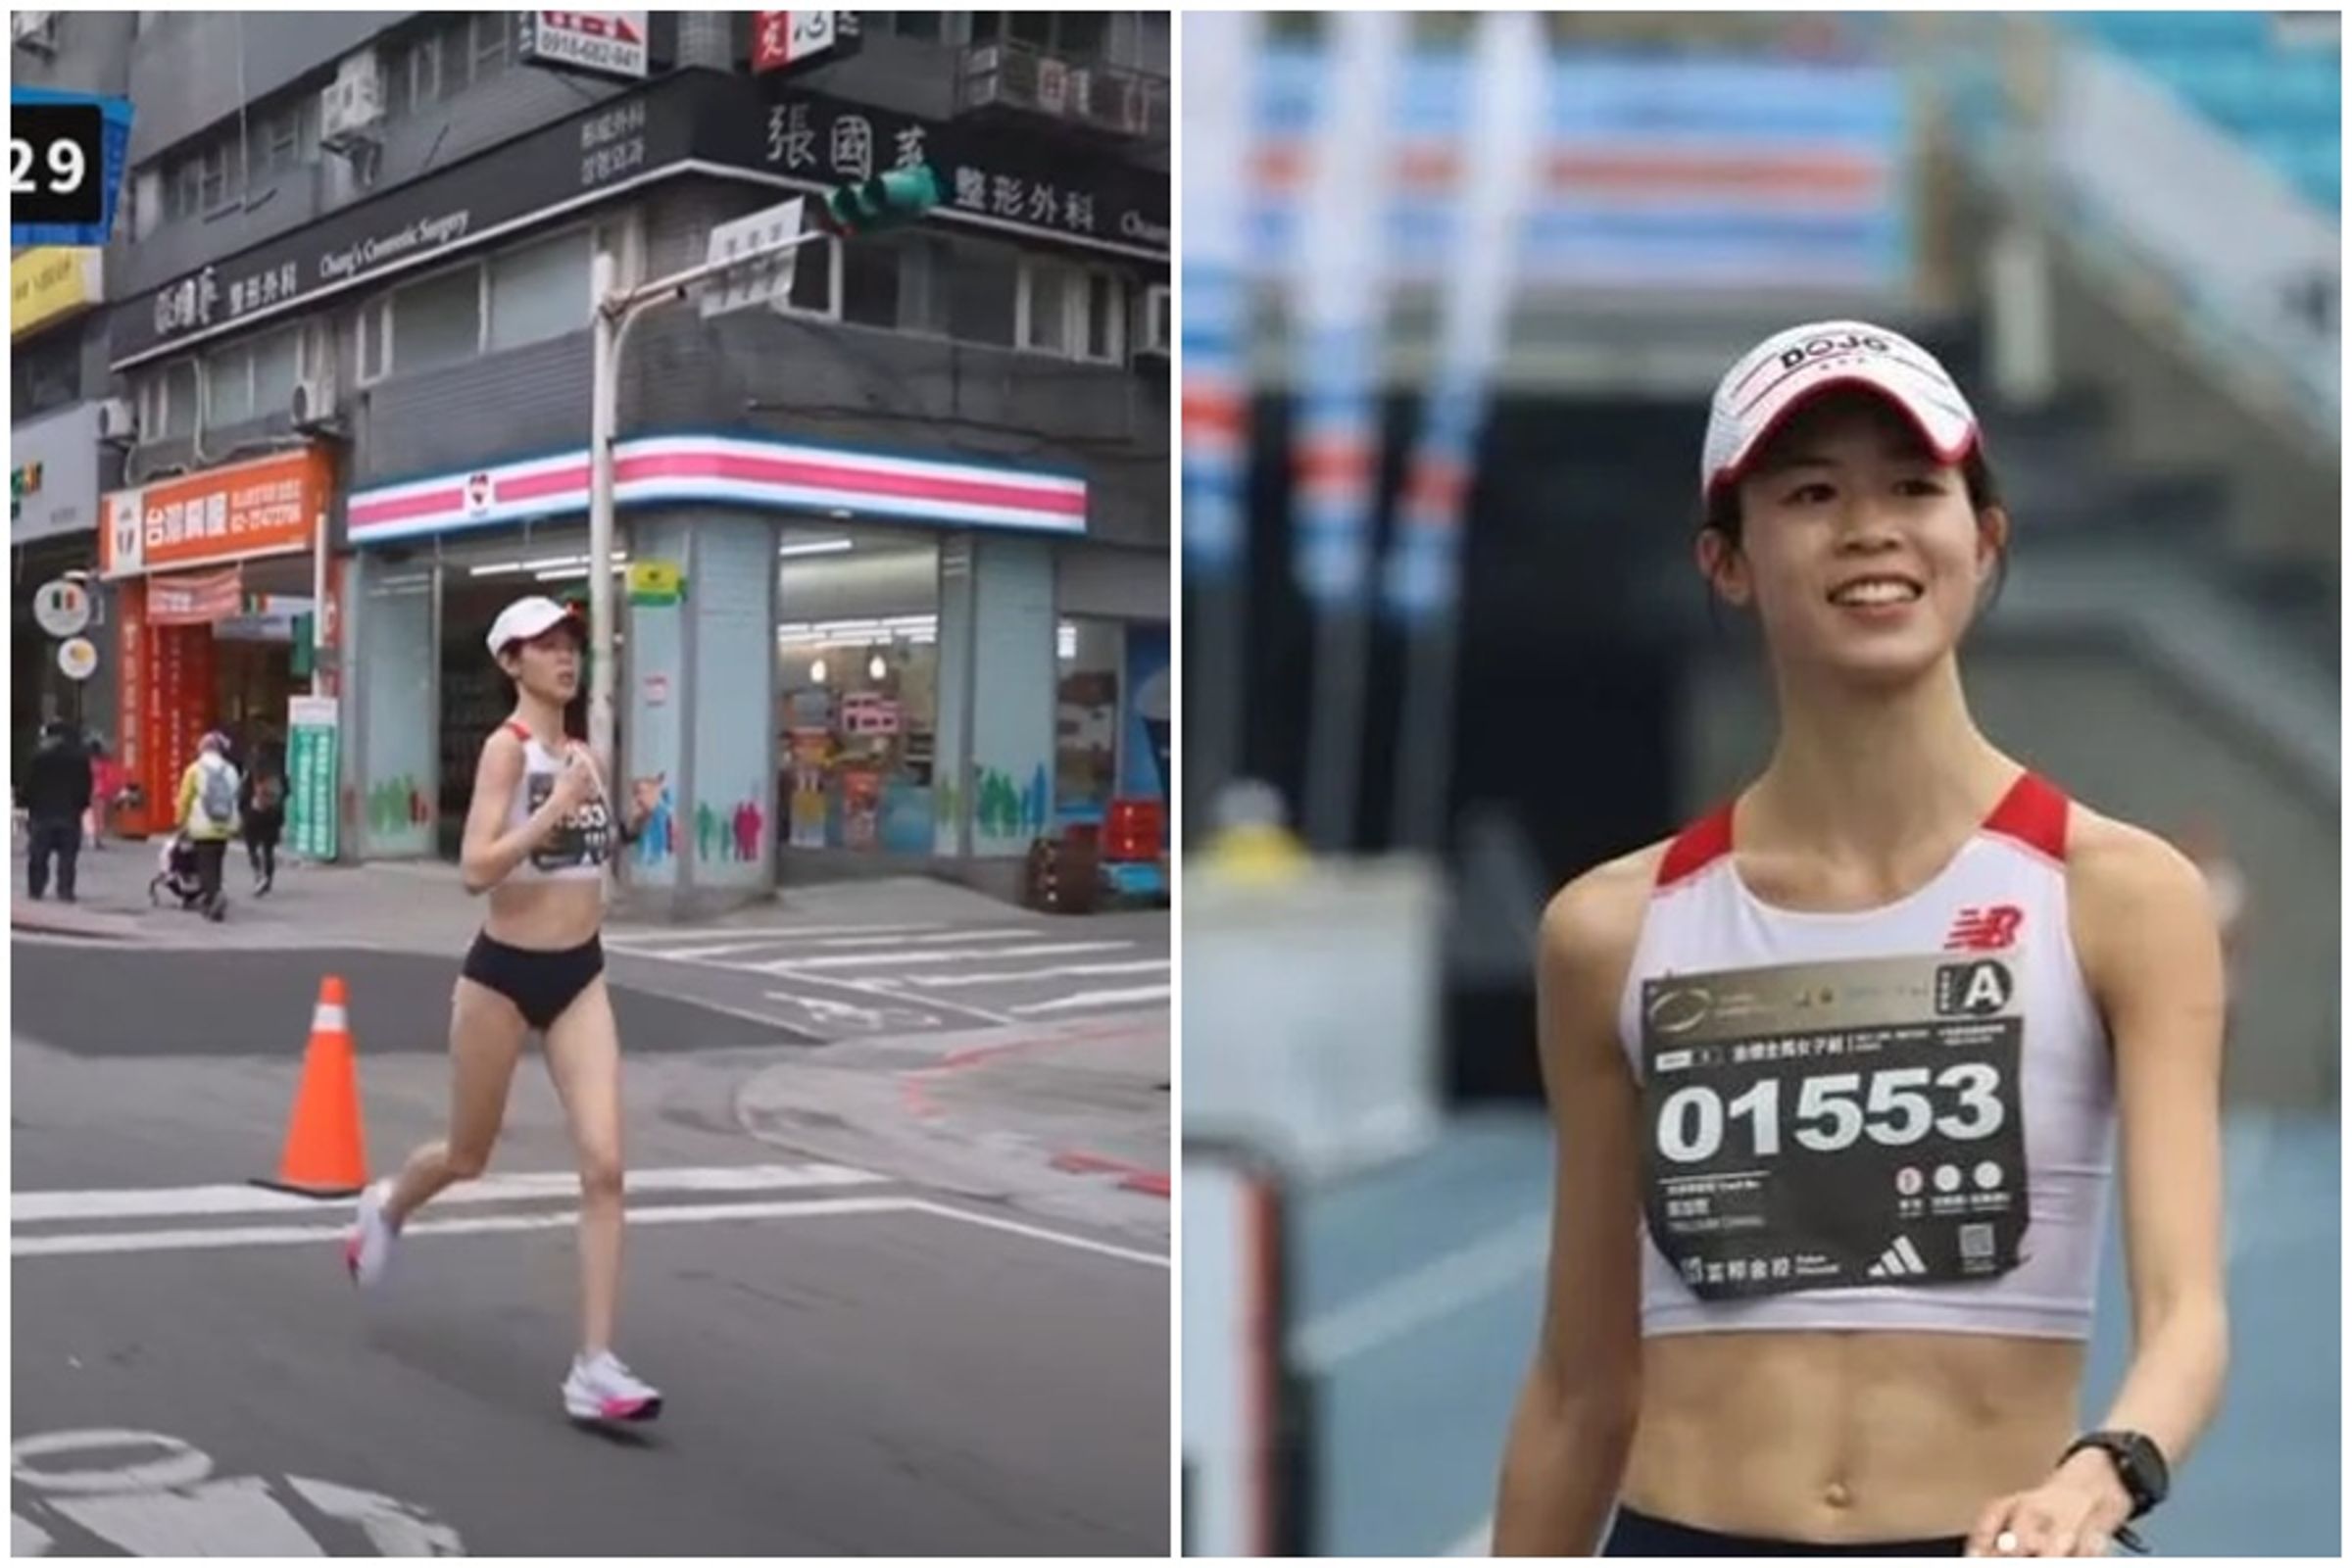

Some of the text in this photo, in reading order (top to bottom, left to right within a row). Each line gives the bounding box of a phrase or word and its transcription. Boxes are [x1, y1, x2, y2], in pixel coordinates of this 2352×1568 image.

[955, 166, 1096, 231] 整形外科
[1964, 965, 2003, 1007] A
[1657, 1063, 2005, 1163] 01553
